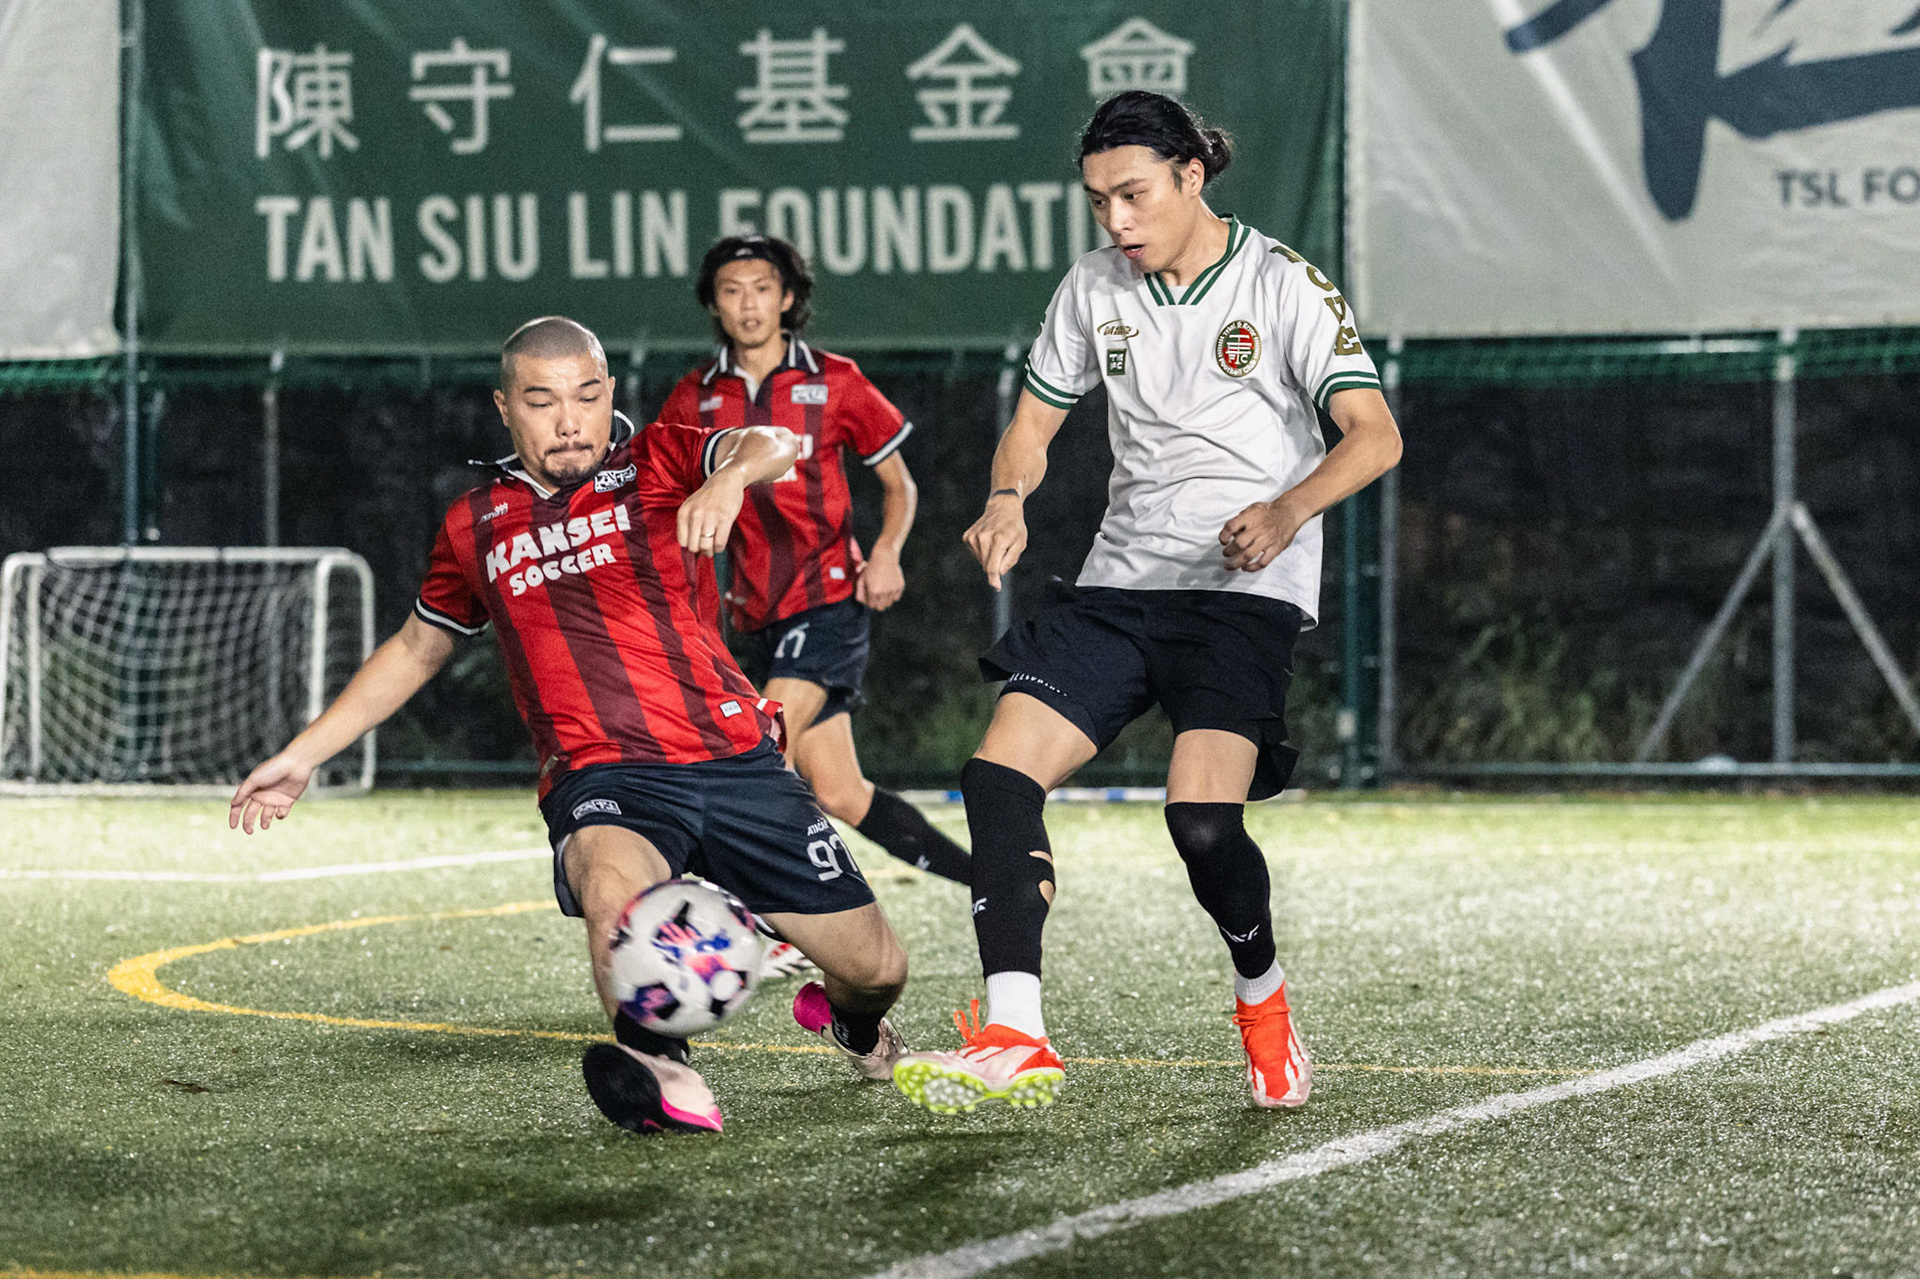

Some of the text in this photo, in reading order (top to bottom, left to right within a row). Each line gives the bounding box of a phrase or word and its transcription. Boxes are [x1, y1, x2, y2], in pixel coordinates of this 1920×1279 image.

[255, 17, 1196, 158] 陳守仁基金會
[1775, 167, 1849, 207] TSL
[255, 181, 1115, 283] TAN SIU LIN FOUNDATI
[485, 504, 631, 583] KANSEI
[509, 543, 616, 596] SOCCER
